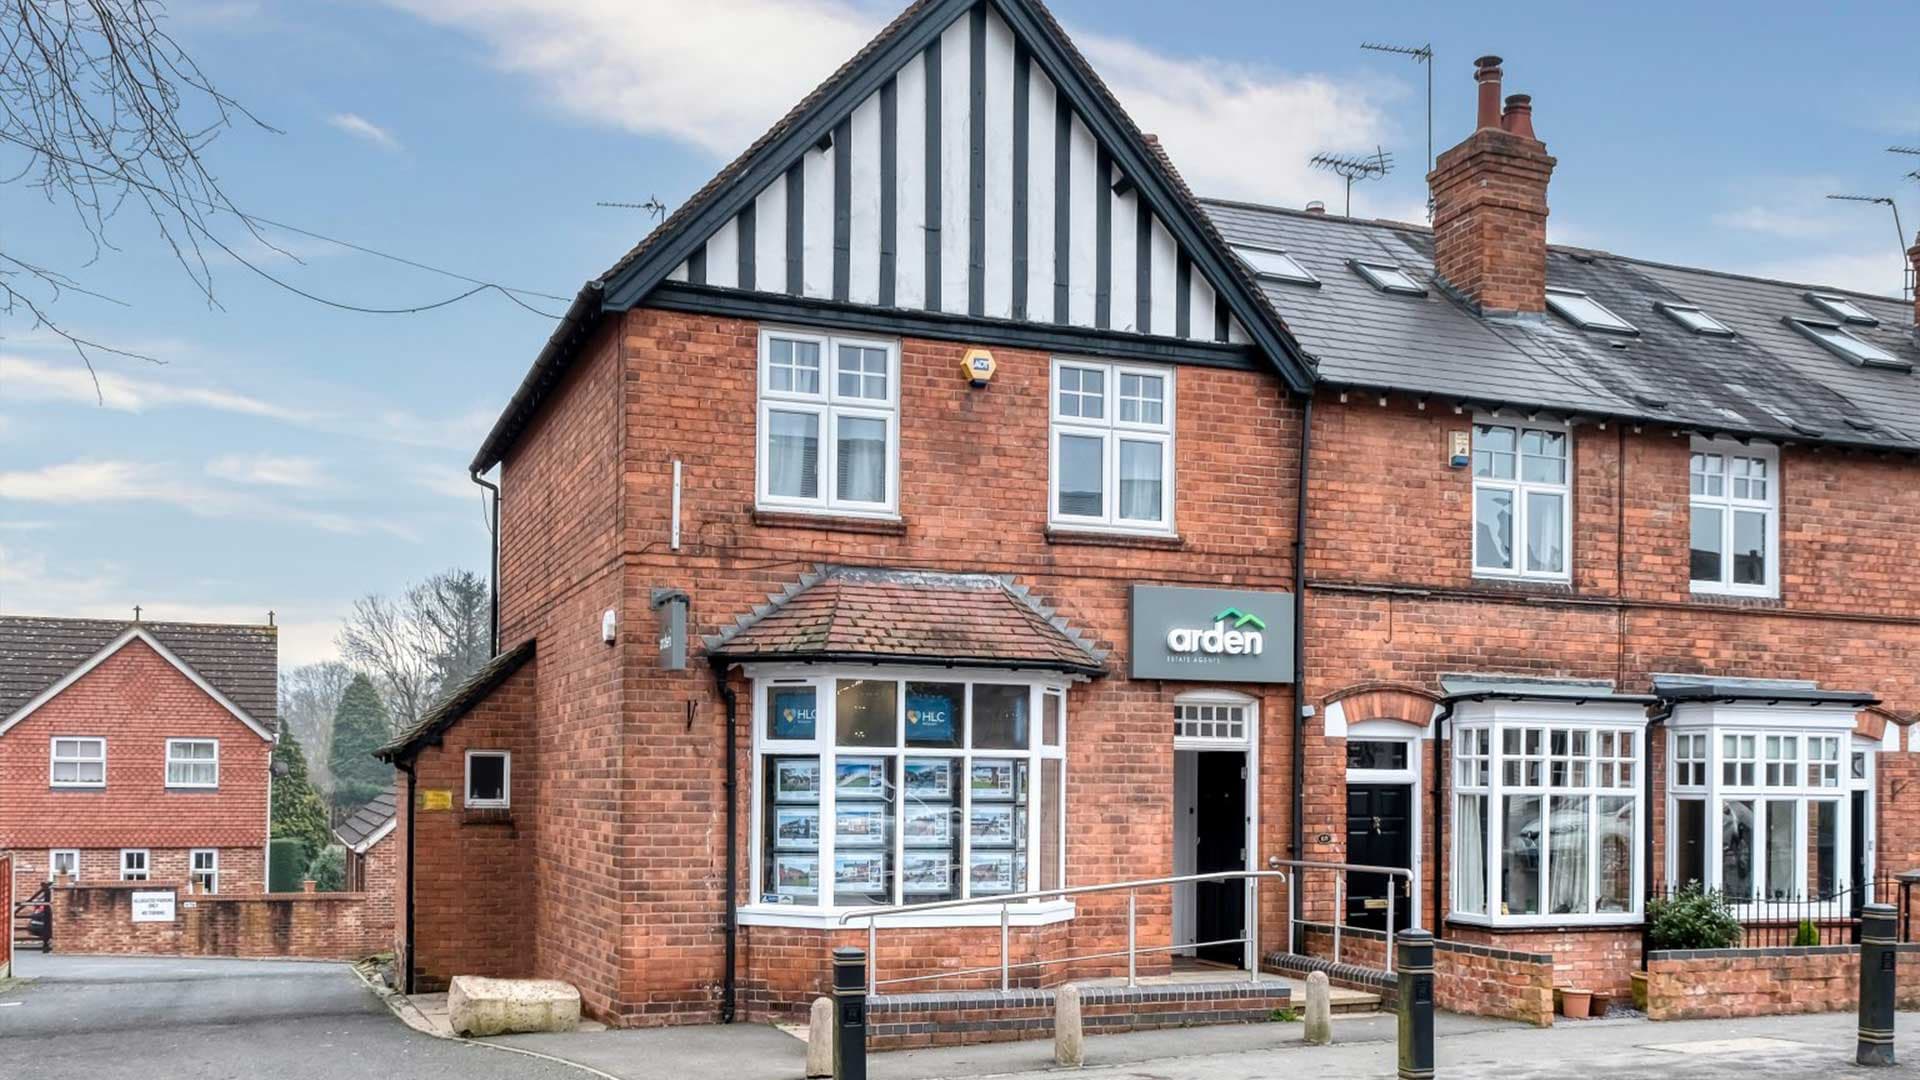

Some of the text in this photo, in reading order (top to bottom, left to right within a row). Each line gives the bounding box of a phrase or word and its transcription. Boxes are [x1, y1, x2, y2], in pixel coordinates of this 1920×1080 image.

[1167, 619, 1263, 655] arden
[1167, 655, 1221, 664] ESTATE AGENTS
[922, 711, 945, 722] HLC
